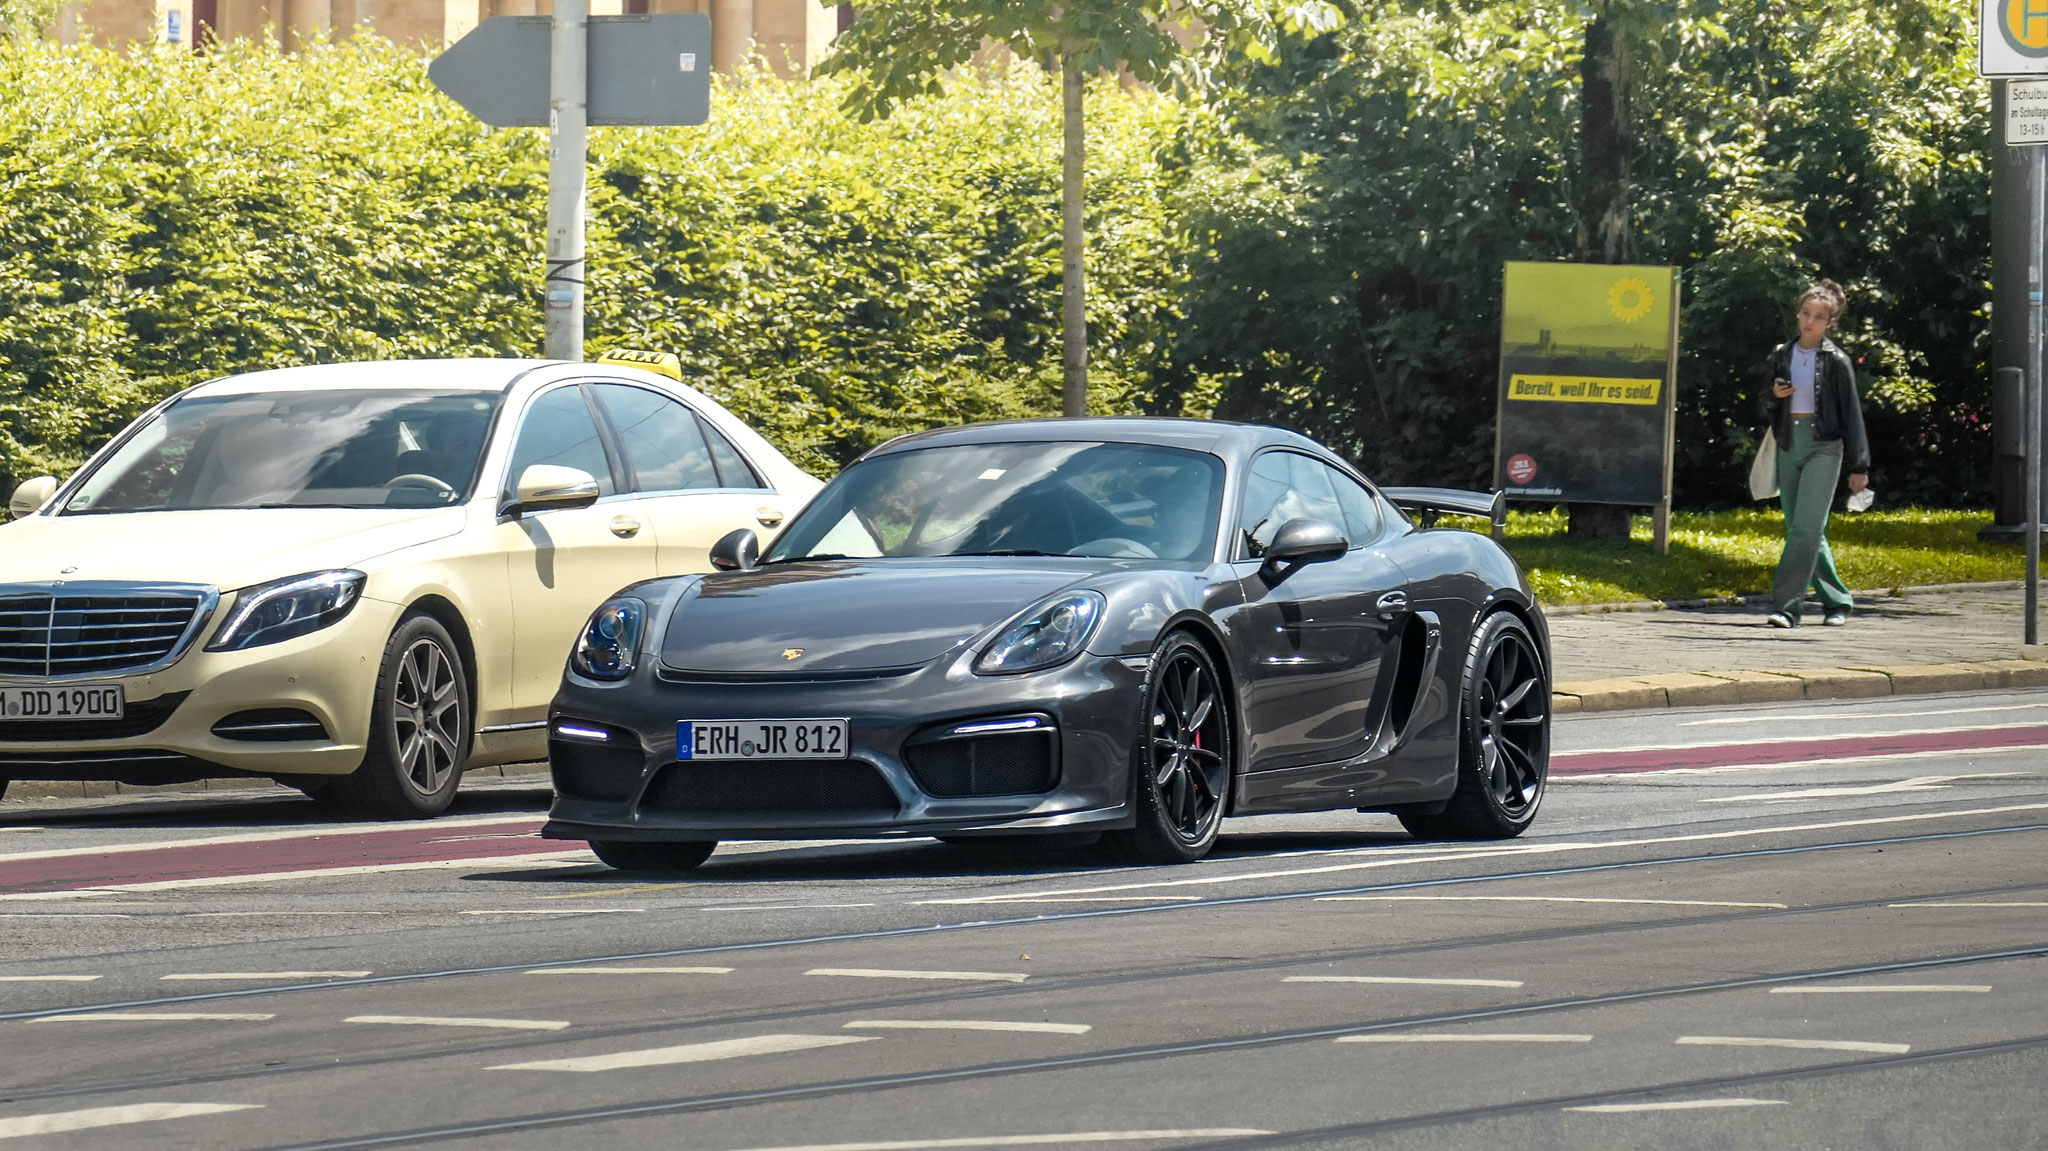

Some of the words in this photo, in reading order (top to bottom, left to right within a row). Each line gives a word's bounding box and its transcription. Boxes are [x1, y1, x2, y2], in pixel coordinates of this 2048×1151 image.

[606, 350, 666, 365] TAXI
[1516, 379, 1556, 397] Bereit,
[1560, 381, 1587, 397] weil
[1588, 382, 1606, 398] Ihr
[1607, 386, 1623, 399] es
[1625, 384, 1654, 400] seid.
[21, 690, 51, 716] DD
[57, 688, 118, 715] 1900
[694, 725, 739, 755] ERH
[756, 725, 787, 754] JR
[795, 725, 841, 754] 812
